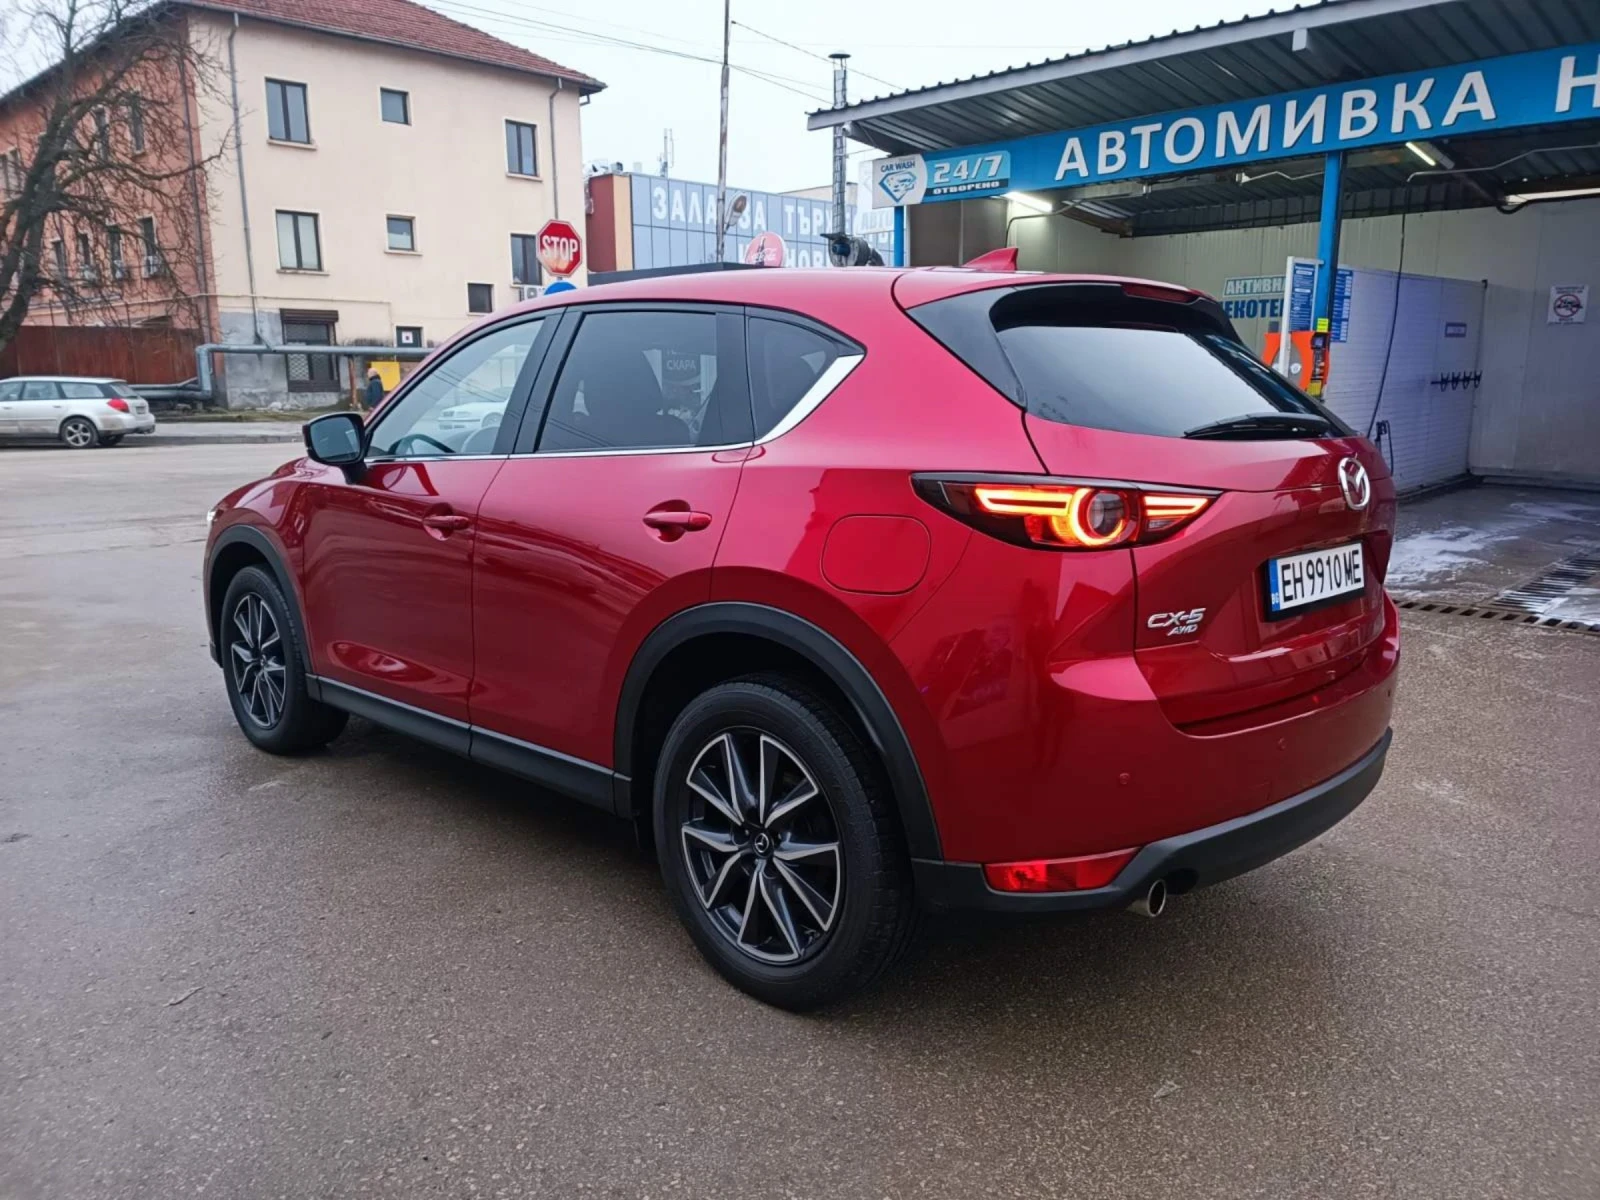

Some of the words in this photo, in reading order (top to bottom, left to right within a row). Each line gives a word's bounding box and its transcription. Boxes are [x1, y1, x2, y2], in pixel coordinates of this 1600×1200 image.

[1055, 71, 1496, 182] АВТОМИВКА
[880, 163, 894, 173] CAR
[895, 161, 916, 172] WASH
[933, 154, 1003, 184] 24/7
[932, 181, 1000, 195] ОТВОРЕНО
[653, 186, 717, 226] ЗАЛА
[541, 234, 579, 262] STOP
[1147, 607, 1207, 628] CX-5
